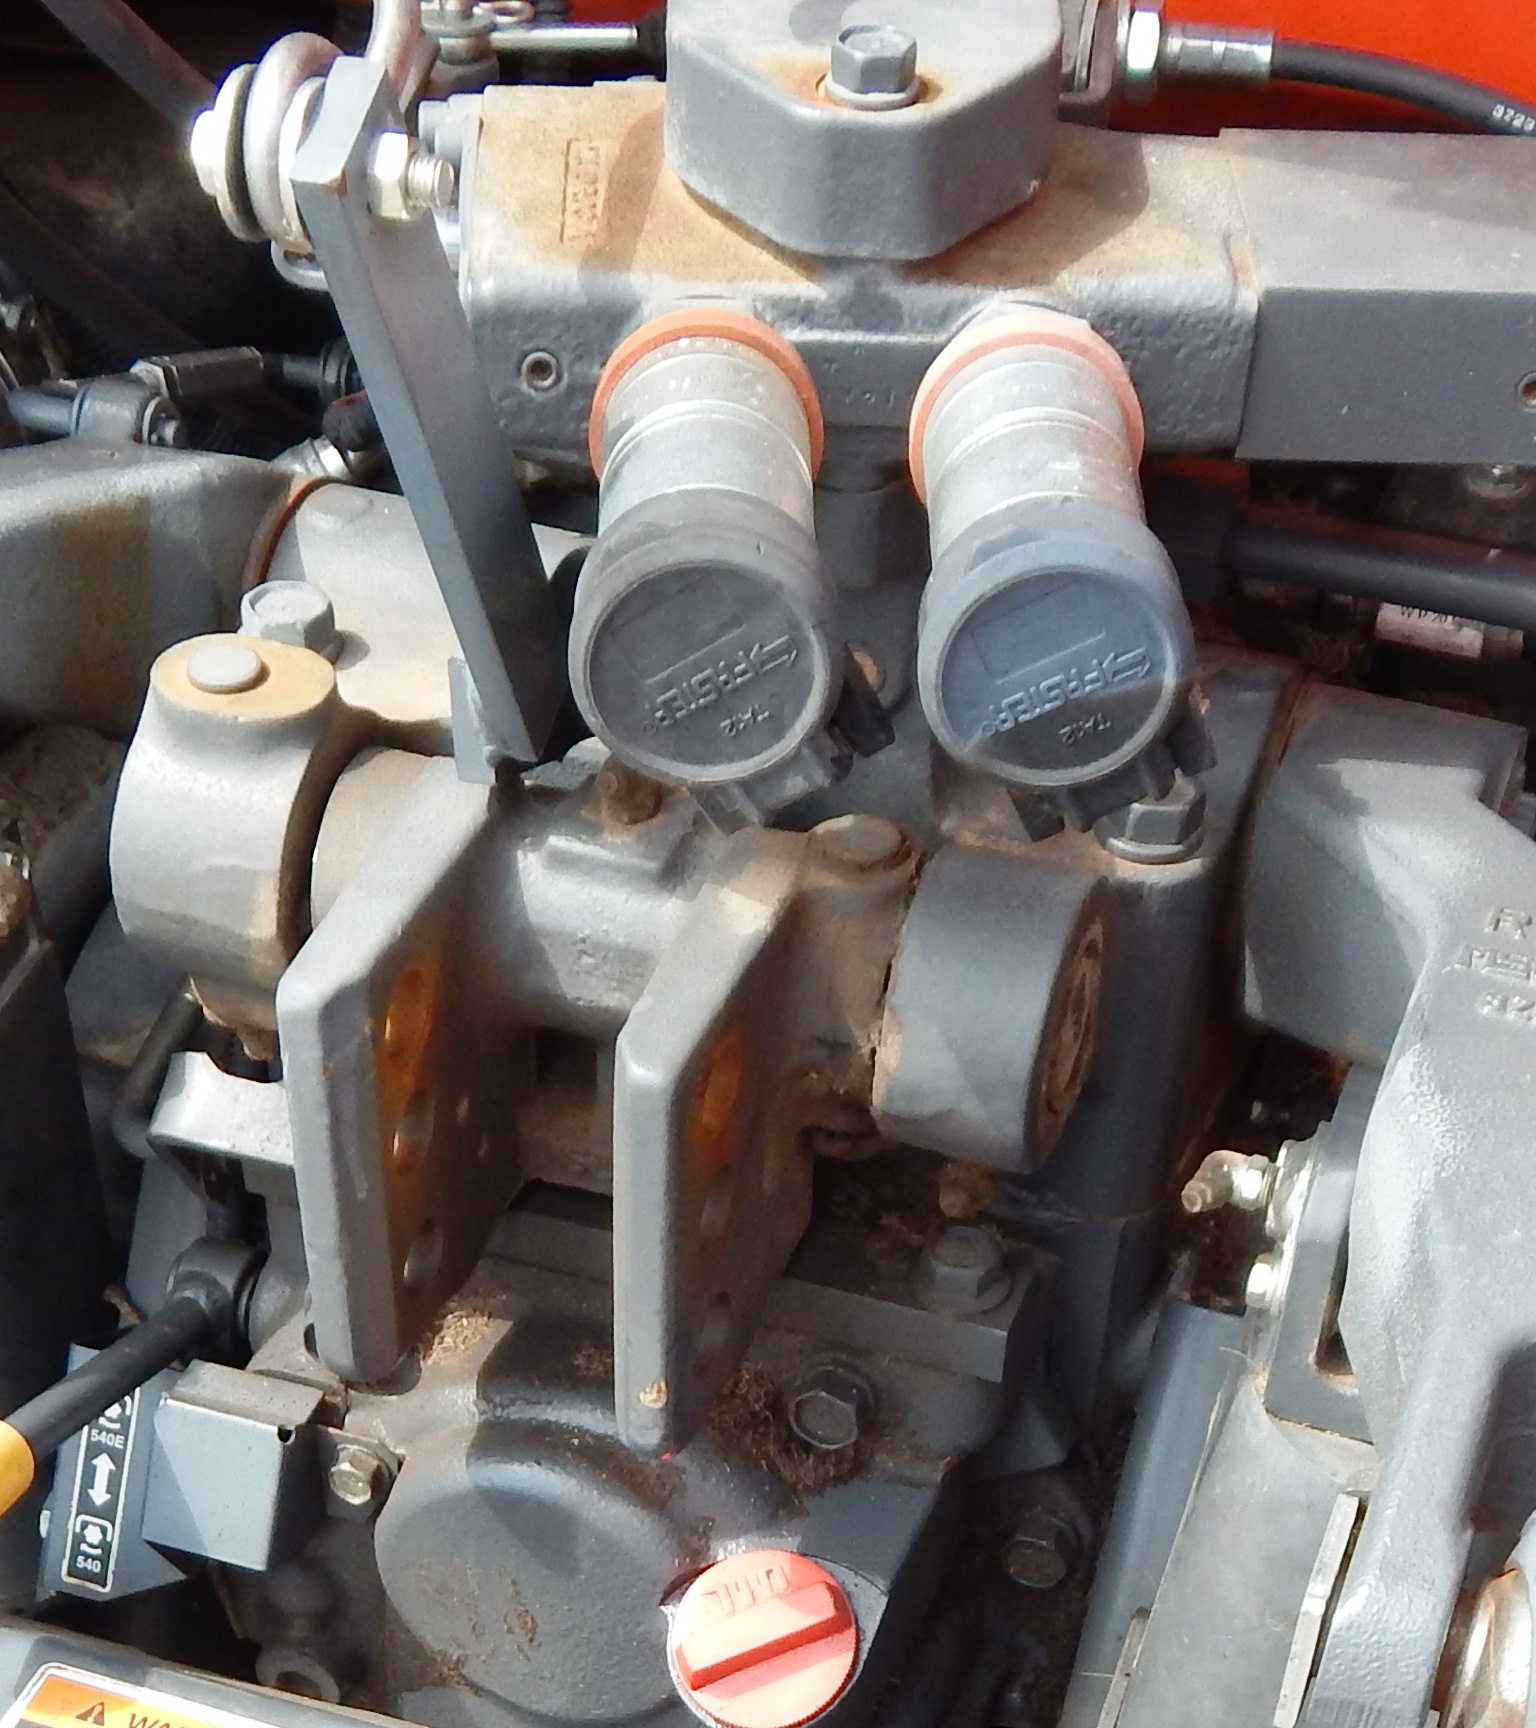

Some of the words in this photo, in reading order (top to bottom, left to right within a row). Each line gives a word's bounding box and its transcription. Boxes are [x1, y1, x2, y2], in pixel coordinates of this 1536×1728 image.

[642, 650, 754, 728] FASTER
[987, 658, 1109, 734] FASTER
[1484, 907, 1532, 939] R
[90, 1428, 126, 1450] 540E
[75, 1555, 103, 1574] 540
